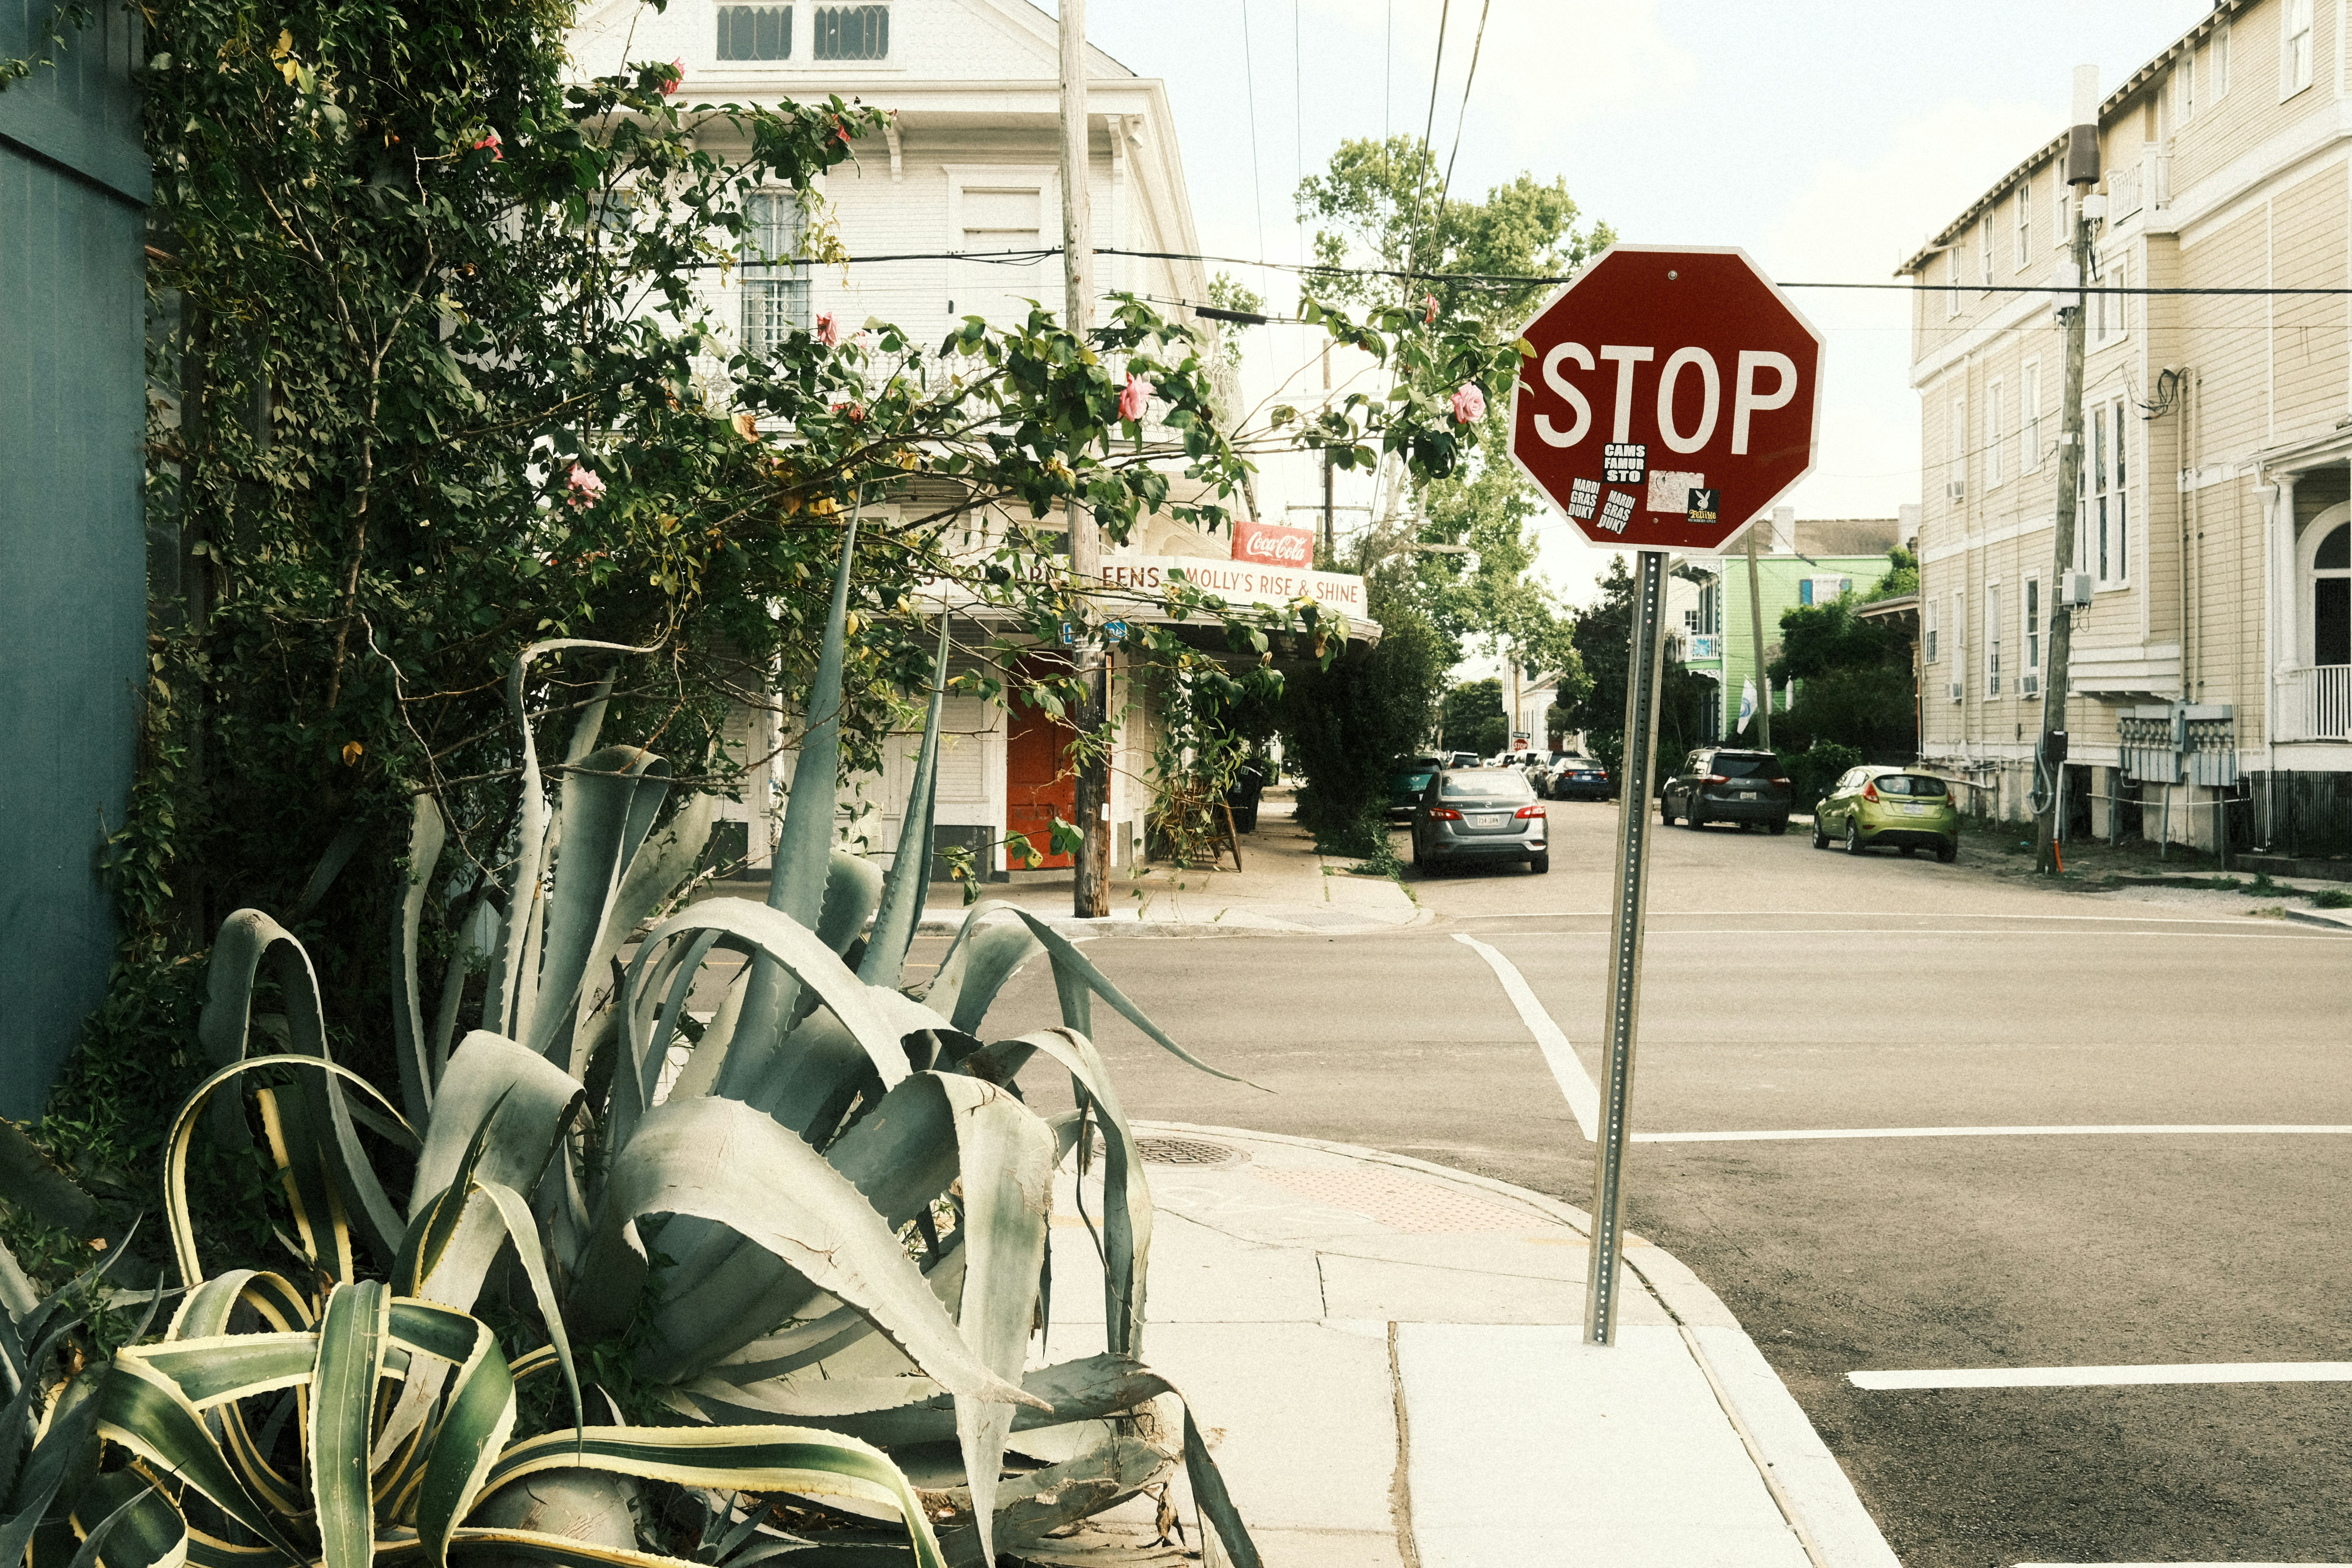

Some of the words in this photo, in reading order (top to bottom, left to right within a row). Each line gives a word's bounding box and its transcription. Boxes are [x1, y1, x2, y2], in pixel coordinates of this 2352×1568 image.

[1534, 342, 1798, 455] STOP
[1604, 444, 1645, 457] CAMS
[1604, 457, 1644, 470] FAMUR
[1607, 470, 1641, 482] STO
[1572, 478, 1601, 495] MARDI
[1570, 490, 1597, 507] GRAS
[1607, 490, 1636, 509] MARDI
[1568, 503, 1595, 519] DUKY
[1603, 502, 1631, 521] GRAS
[1598, 514, 1627, 534] DUKY
[1246, 531, 1308, 561] Coca-Cola
[1102, 567, 1159, 588] EENS
[1185, 567, 1253, 592] MOLLY'S
[1260, 575, 1293, 596] RISE
[1298, 579, 1309, 596] &
[1316, 582, 1358, 603] SHINE
